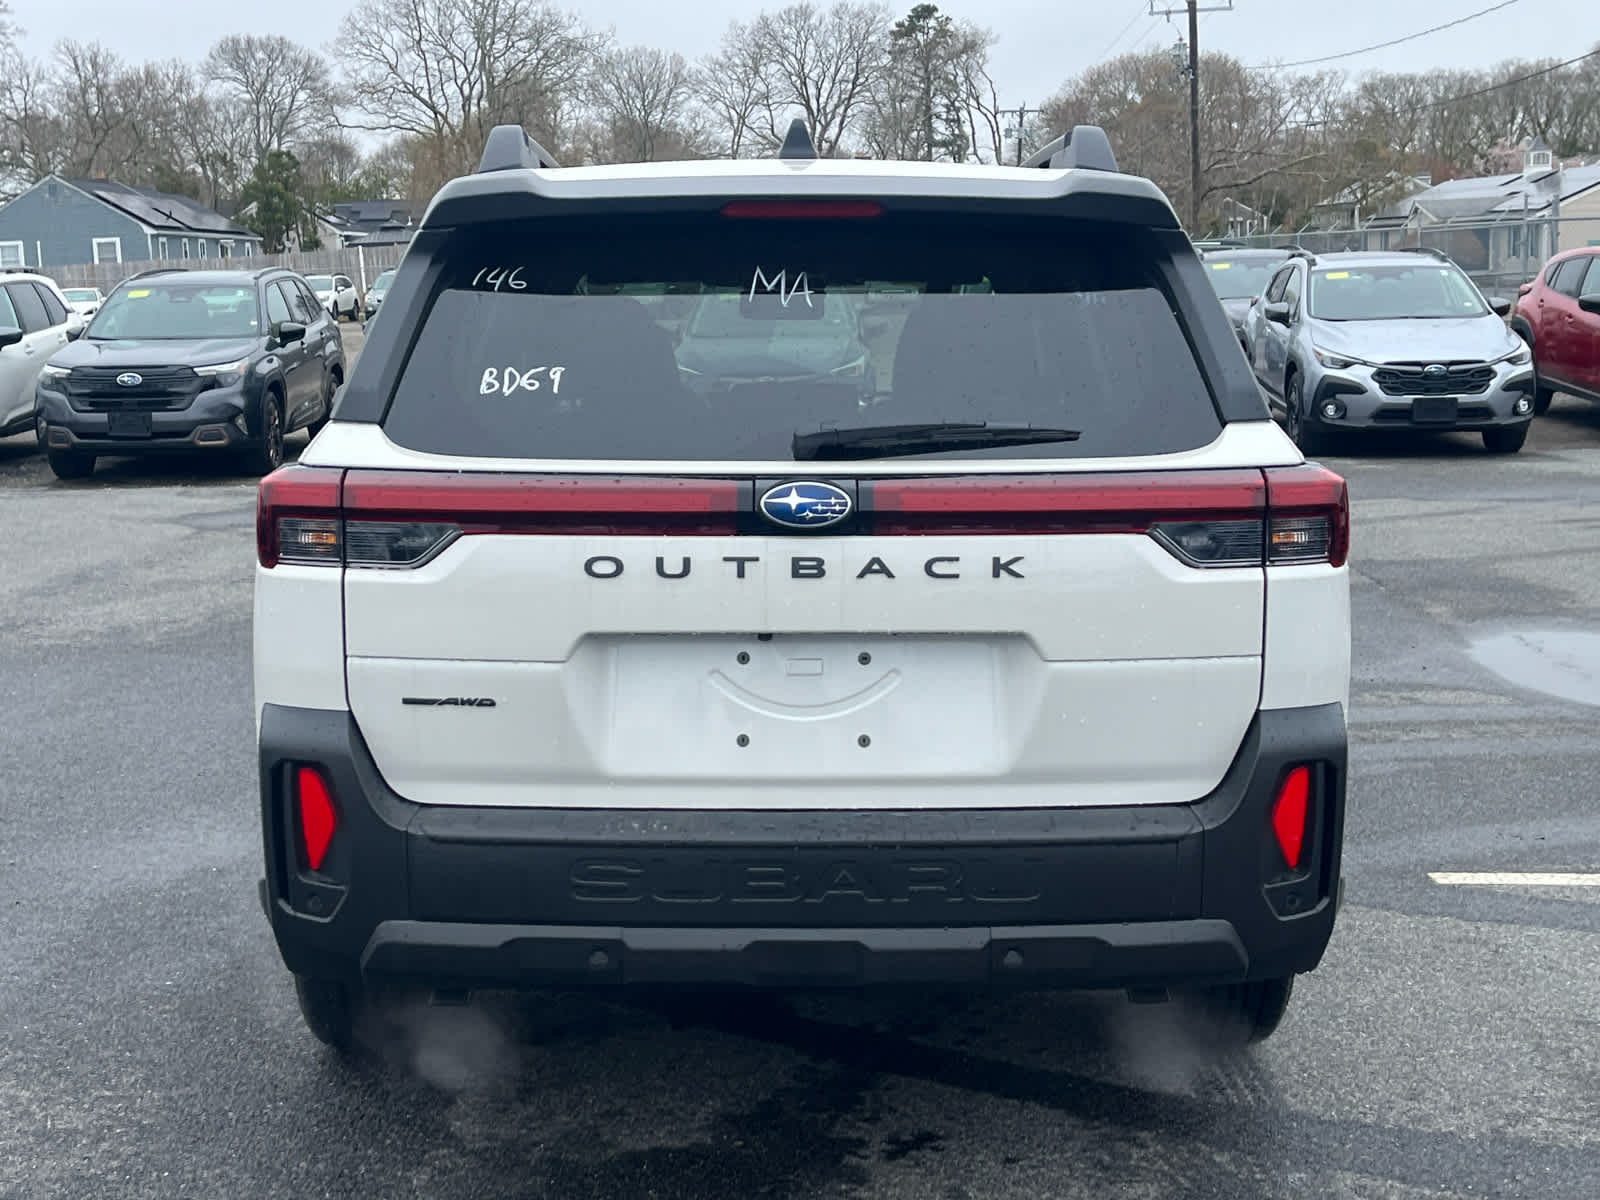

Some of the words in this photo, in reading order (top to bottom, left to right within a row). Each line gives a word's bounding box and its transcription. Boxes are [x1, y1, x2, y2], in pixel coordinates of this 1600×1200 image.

[472, 266, 528, 291] 146
[749, 265, 815, 308] MA
[479, 366, 566, 396] BD69
[583, 555, 1025, 579] OUTBACK
[436, 697, 497, 707] AWD
[569, 857, 1042, 903] SUBARU
